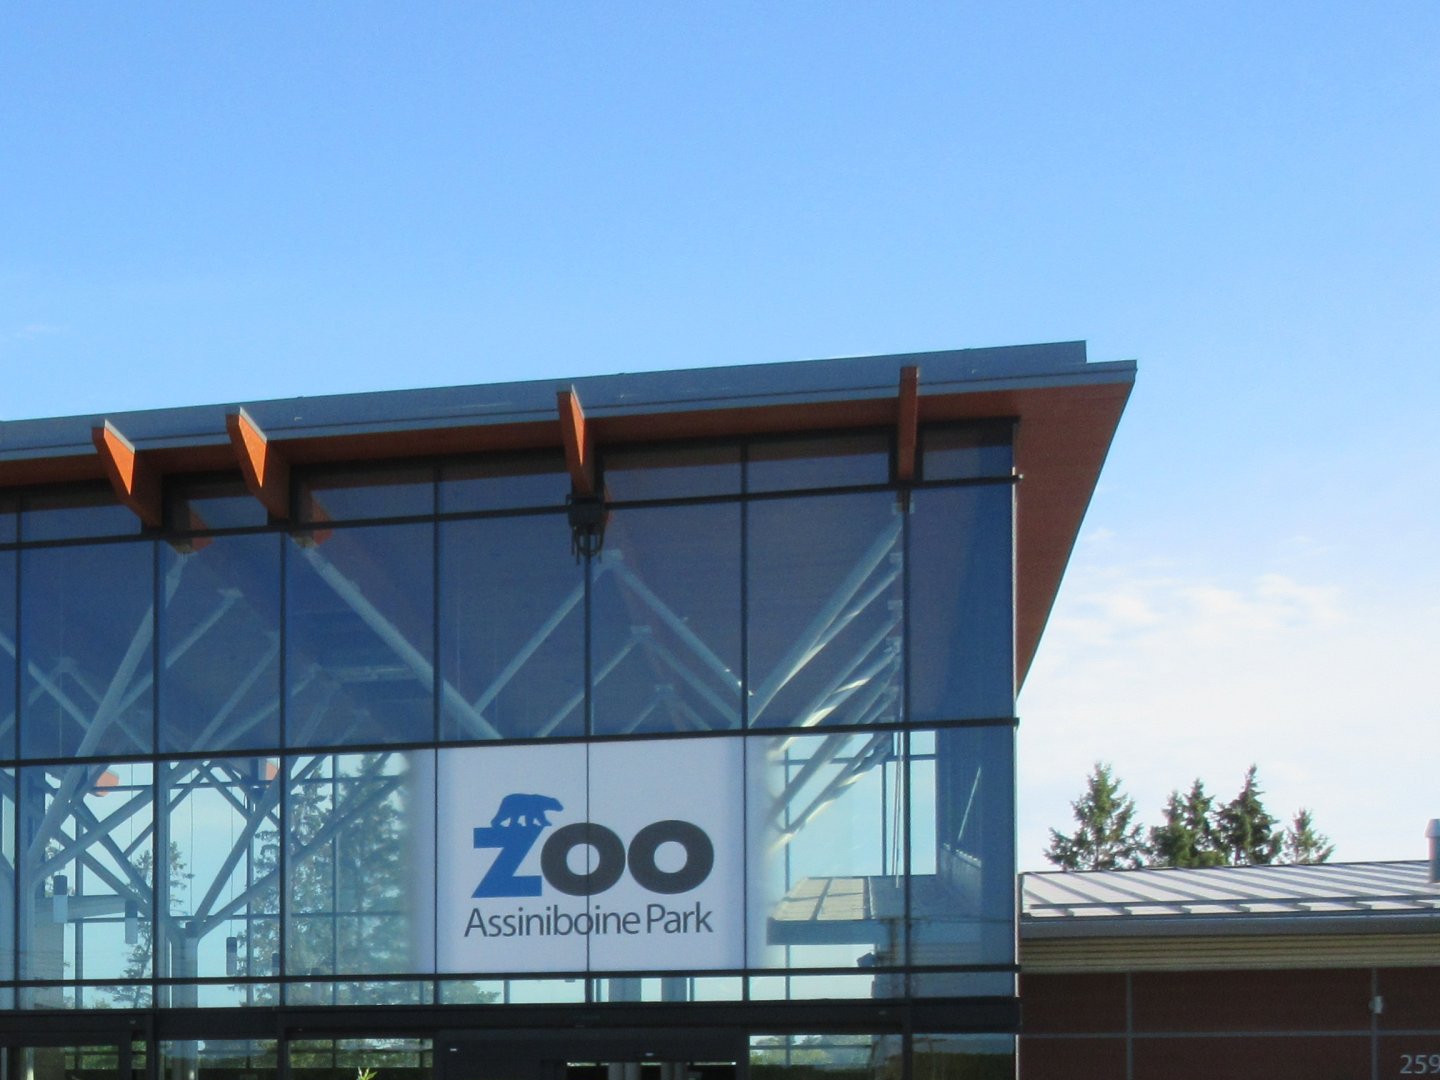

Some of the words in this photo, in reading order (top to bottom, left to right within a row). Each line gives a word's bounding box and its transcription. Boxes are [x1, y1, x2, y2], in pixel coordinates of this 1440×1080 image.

[470, 819, 715, 898] ZOO
[464, 904, 641, 938] Assiniboine
[646, 901, 713, 934] Park
[1399, 1054, 1440, 1075] 259
